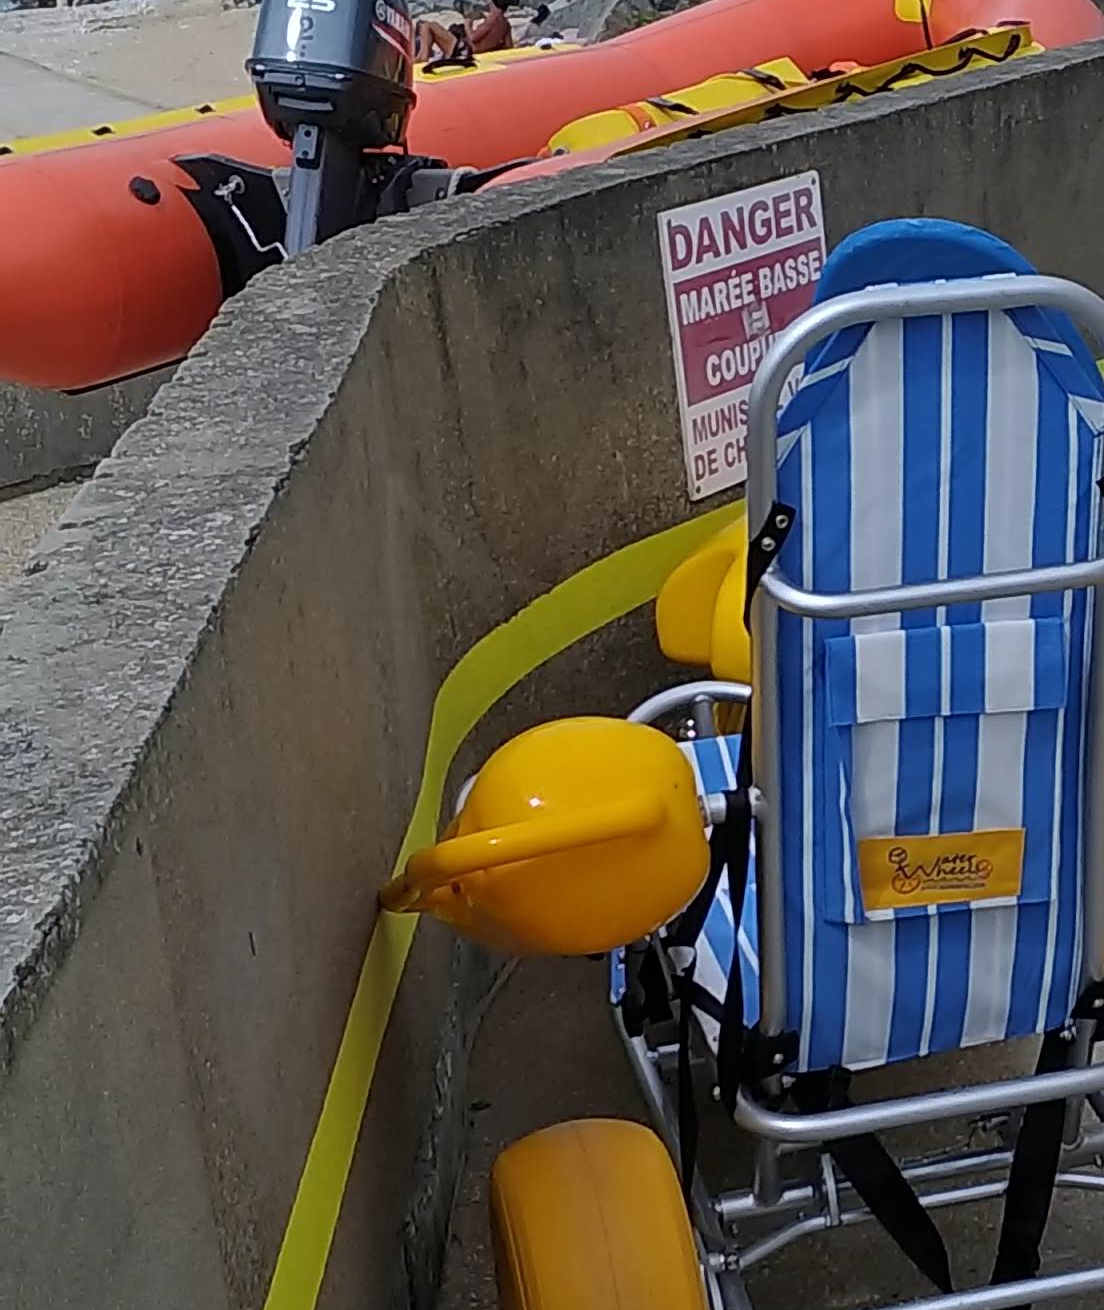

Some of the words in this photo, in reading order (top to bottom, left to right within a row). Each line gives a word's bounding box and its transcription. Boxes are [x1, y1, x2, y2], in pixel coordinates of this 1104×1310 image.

[667, 187, 817, 271] DANGER
[680, 269, 755, 325] MARÉE
[759, 251, 821, 299] BASSE
[706, 335, 774, 386] COUP
[692, 399, 749, 445] MUNIS
[694, 448, 719, 481] DE
[724, 436, 748, 469] CH
